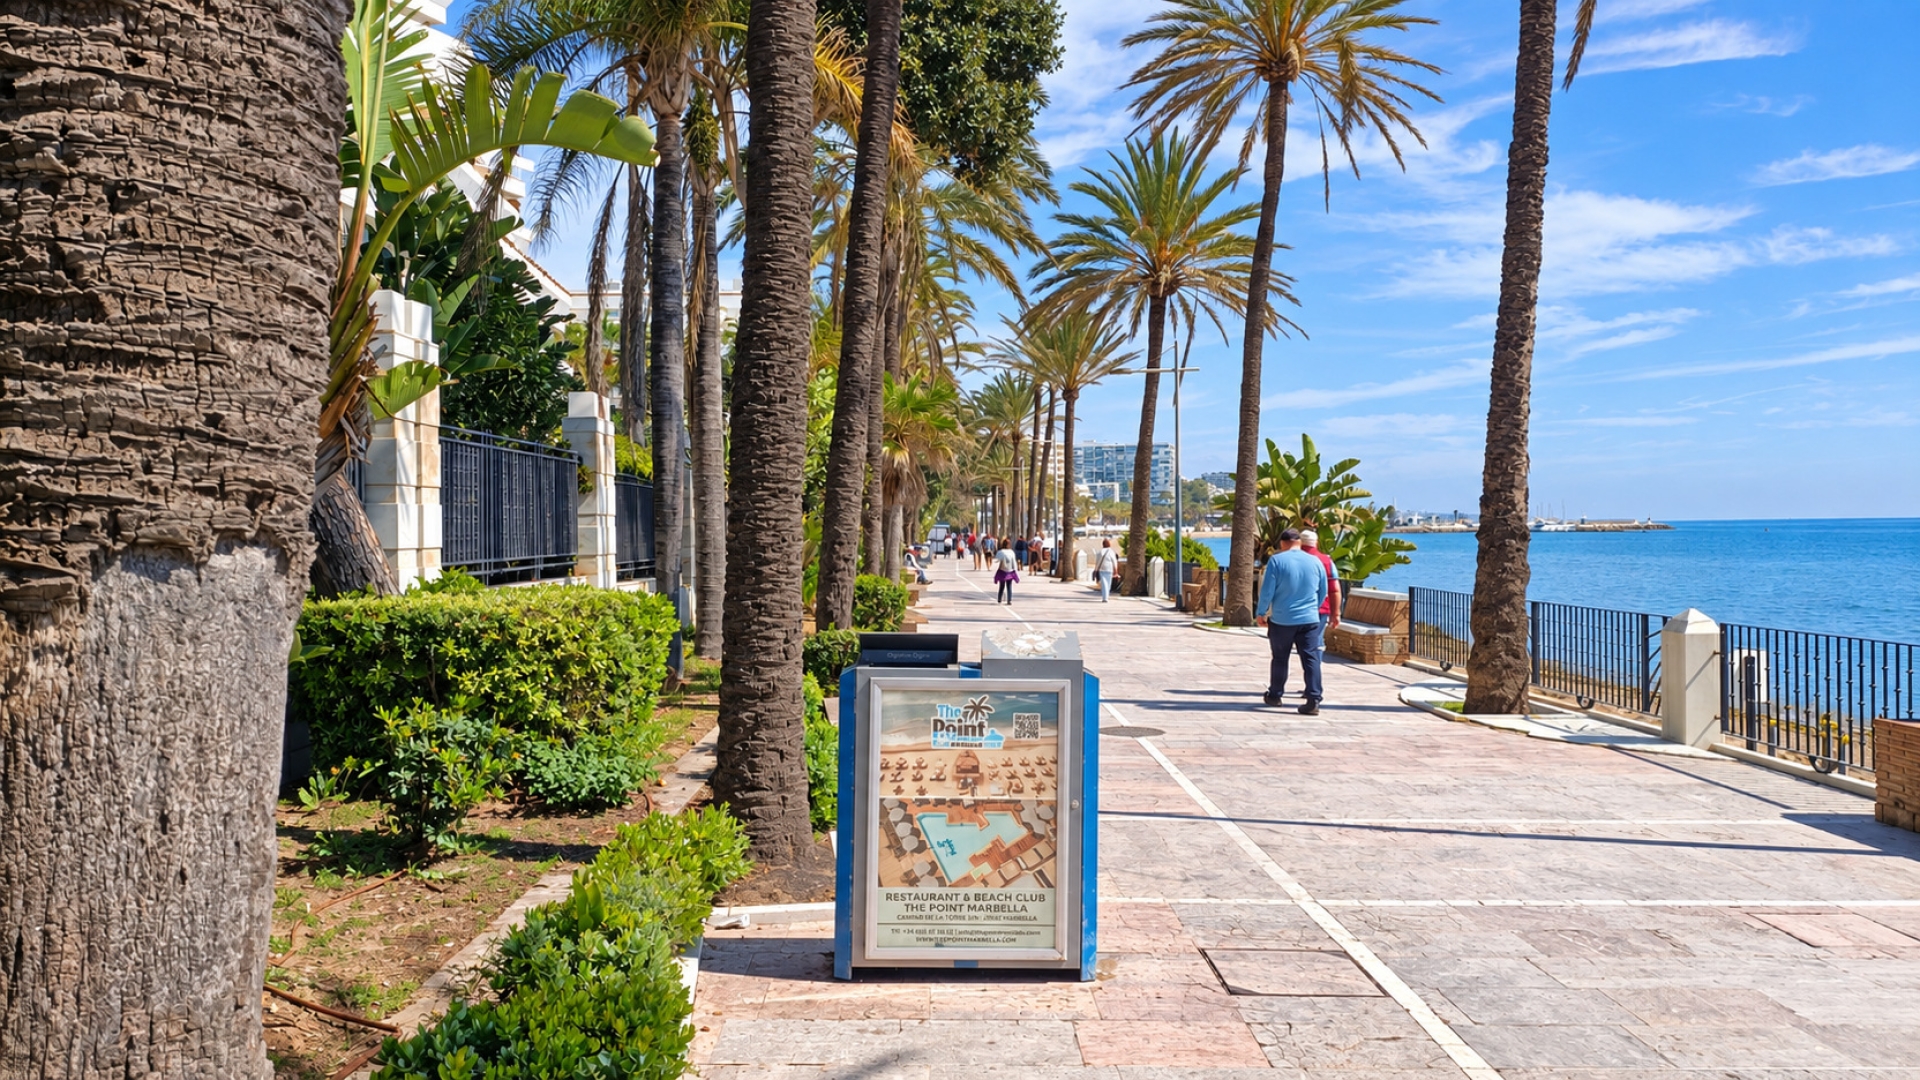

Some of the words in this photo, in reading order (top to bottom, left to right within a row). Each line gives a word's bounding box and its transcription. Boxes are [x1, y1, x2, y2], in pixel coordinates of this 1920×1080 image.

[937, 704, 961, 718] The
[932, 718, 985, 738] Point
[885, 892, 960, 902] RESTAURANT
[974, 893, 1012, 902] BEACH
[1015, 893, 1046, 902] CLUB
[904, 903, 926, 912] THE
[929, 903, 965, 913] POINT
[967, 904, 1028, 913] MARBELLA
